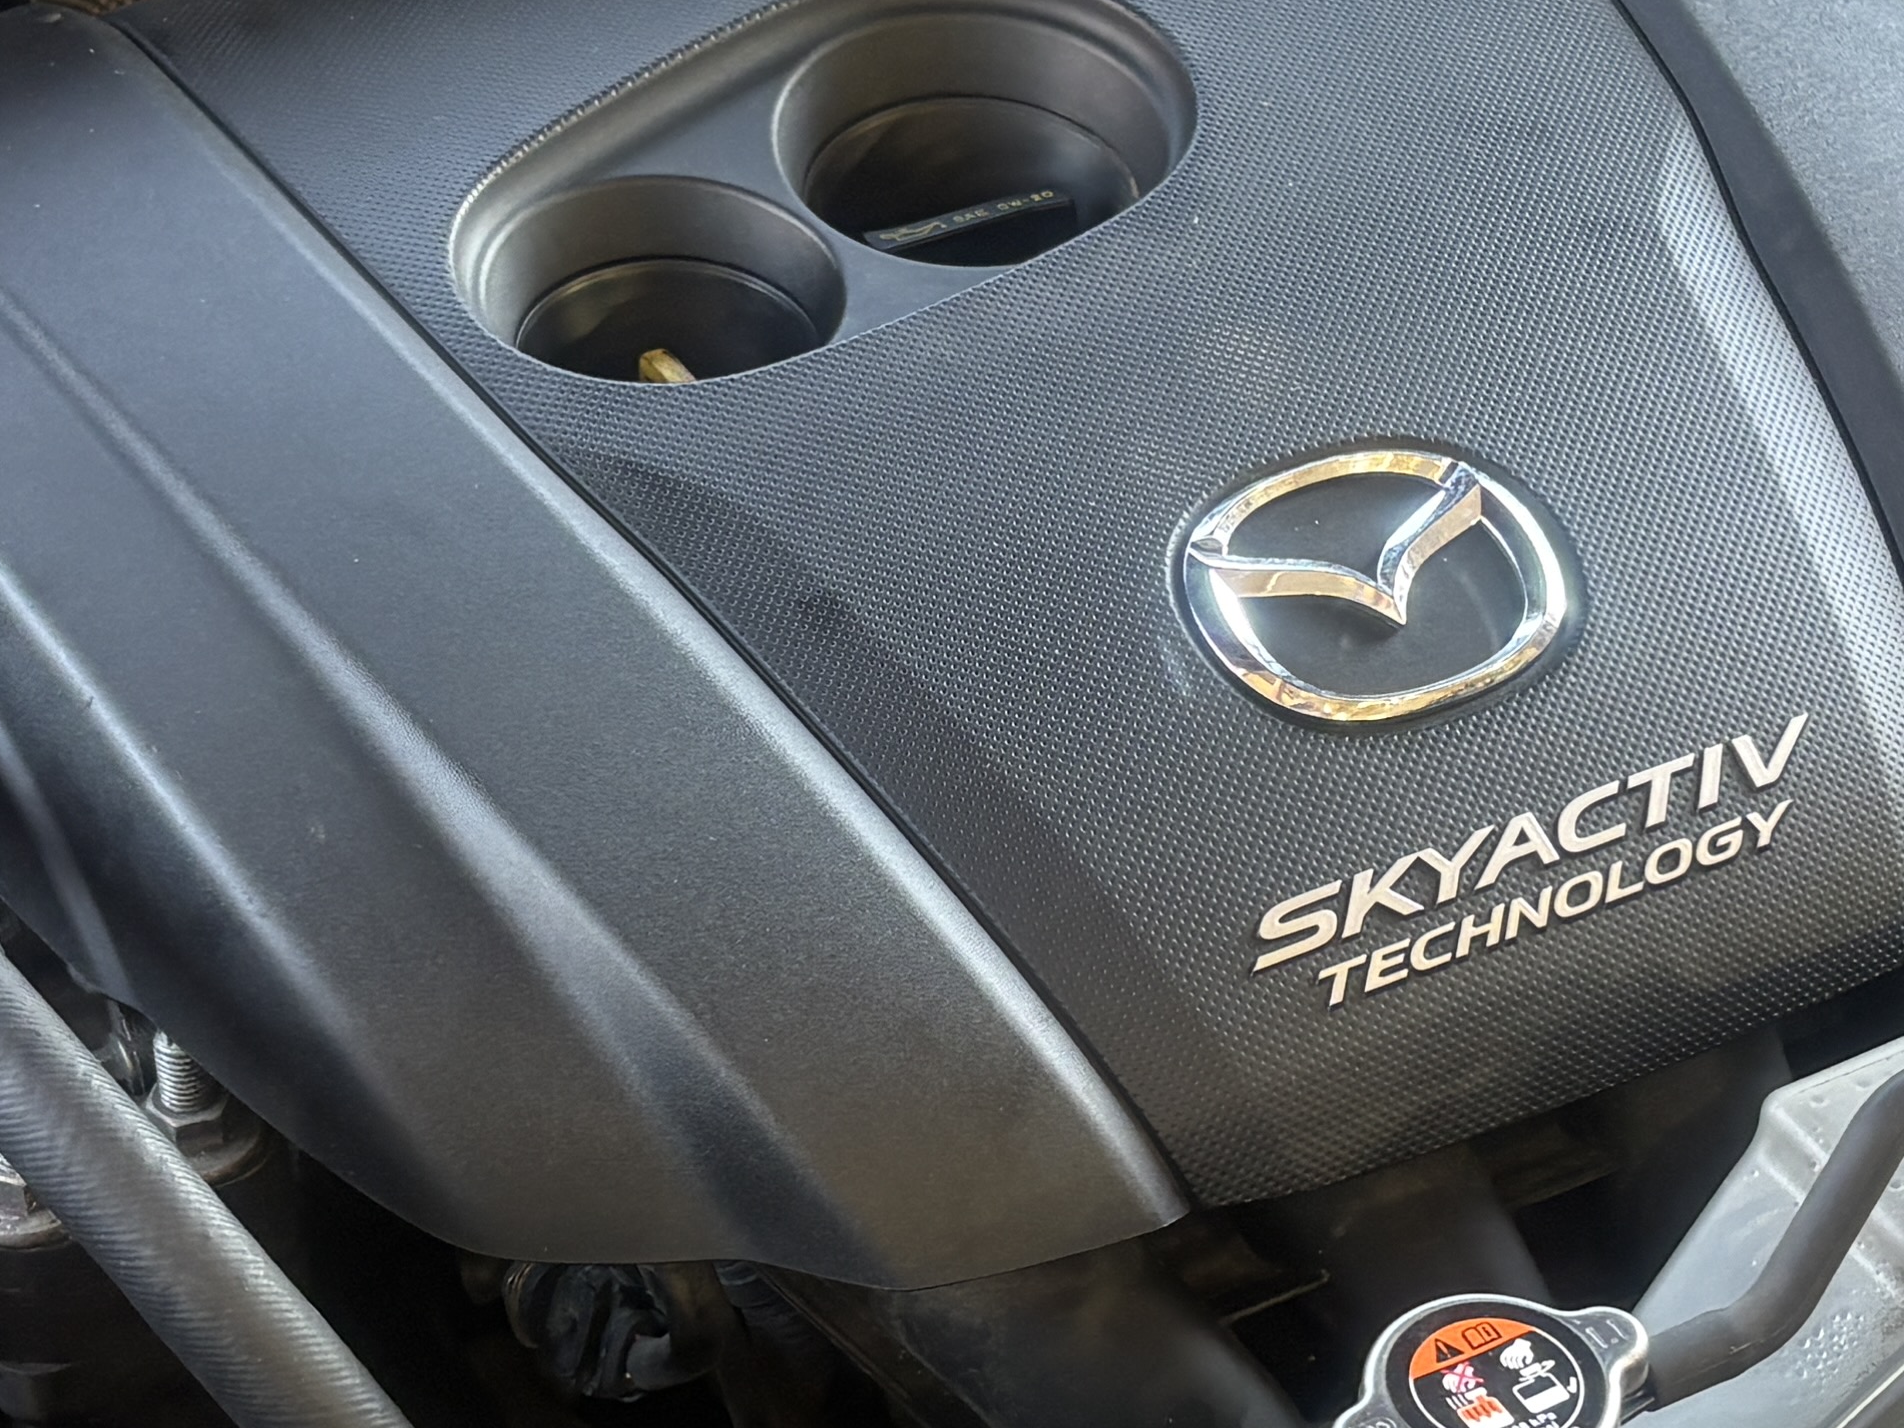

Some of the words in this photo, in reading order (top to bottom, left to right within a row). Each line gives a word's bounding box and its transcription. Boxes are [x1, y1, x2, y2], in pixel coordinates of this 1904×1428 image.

[952, 208, 990, 225] SAE
[1251, 713, 1810, 977] SKYACTIV
[1317, 797, 1794, 1009] TECHNOLOGY
[1528, 1412, 1558, 1428] kPa
